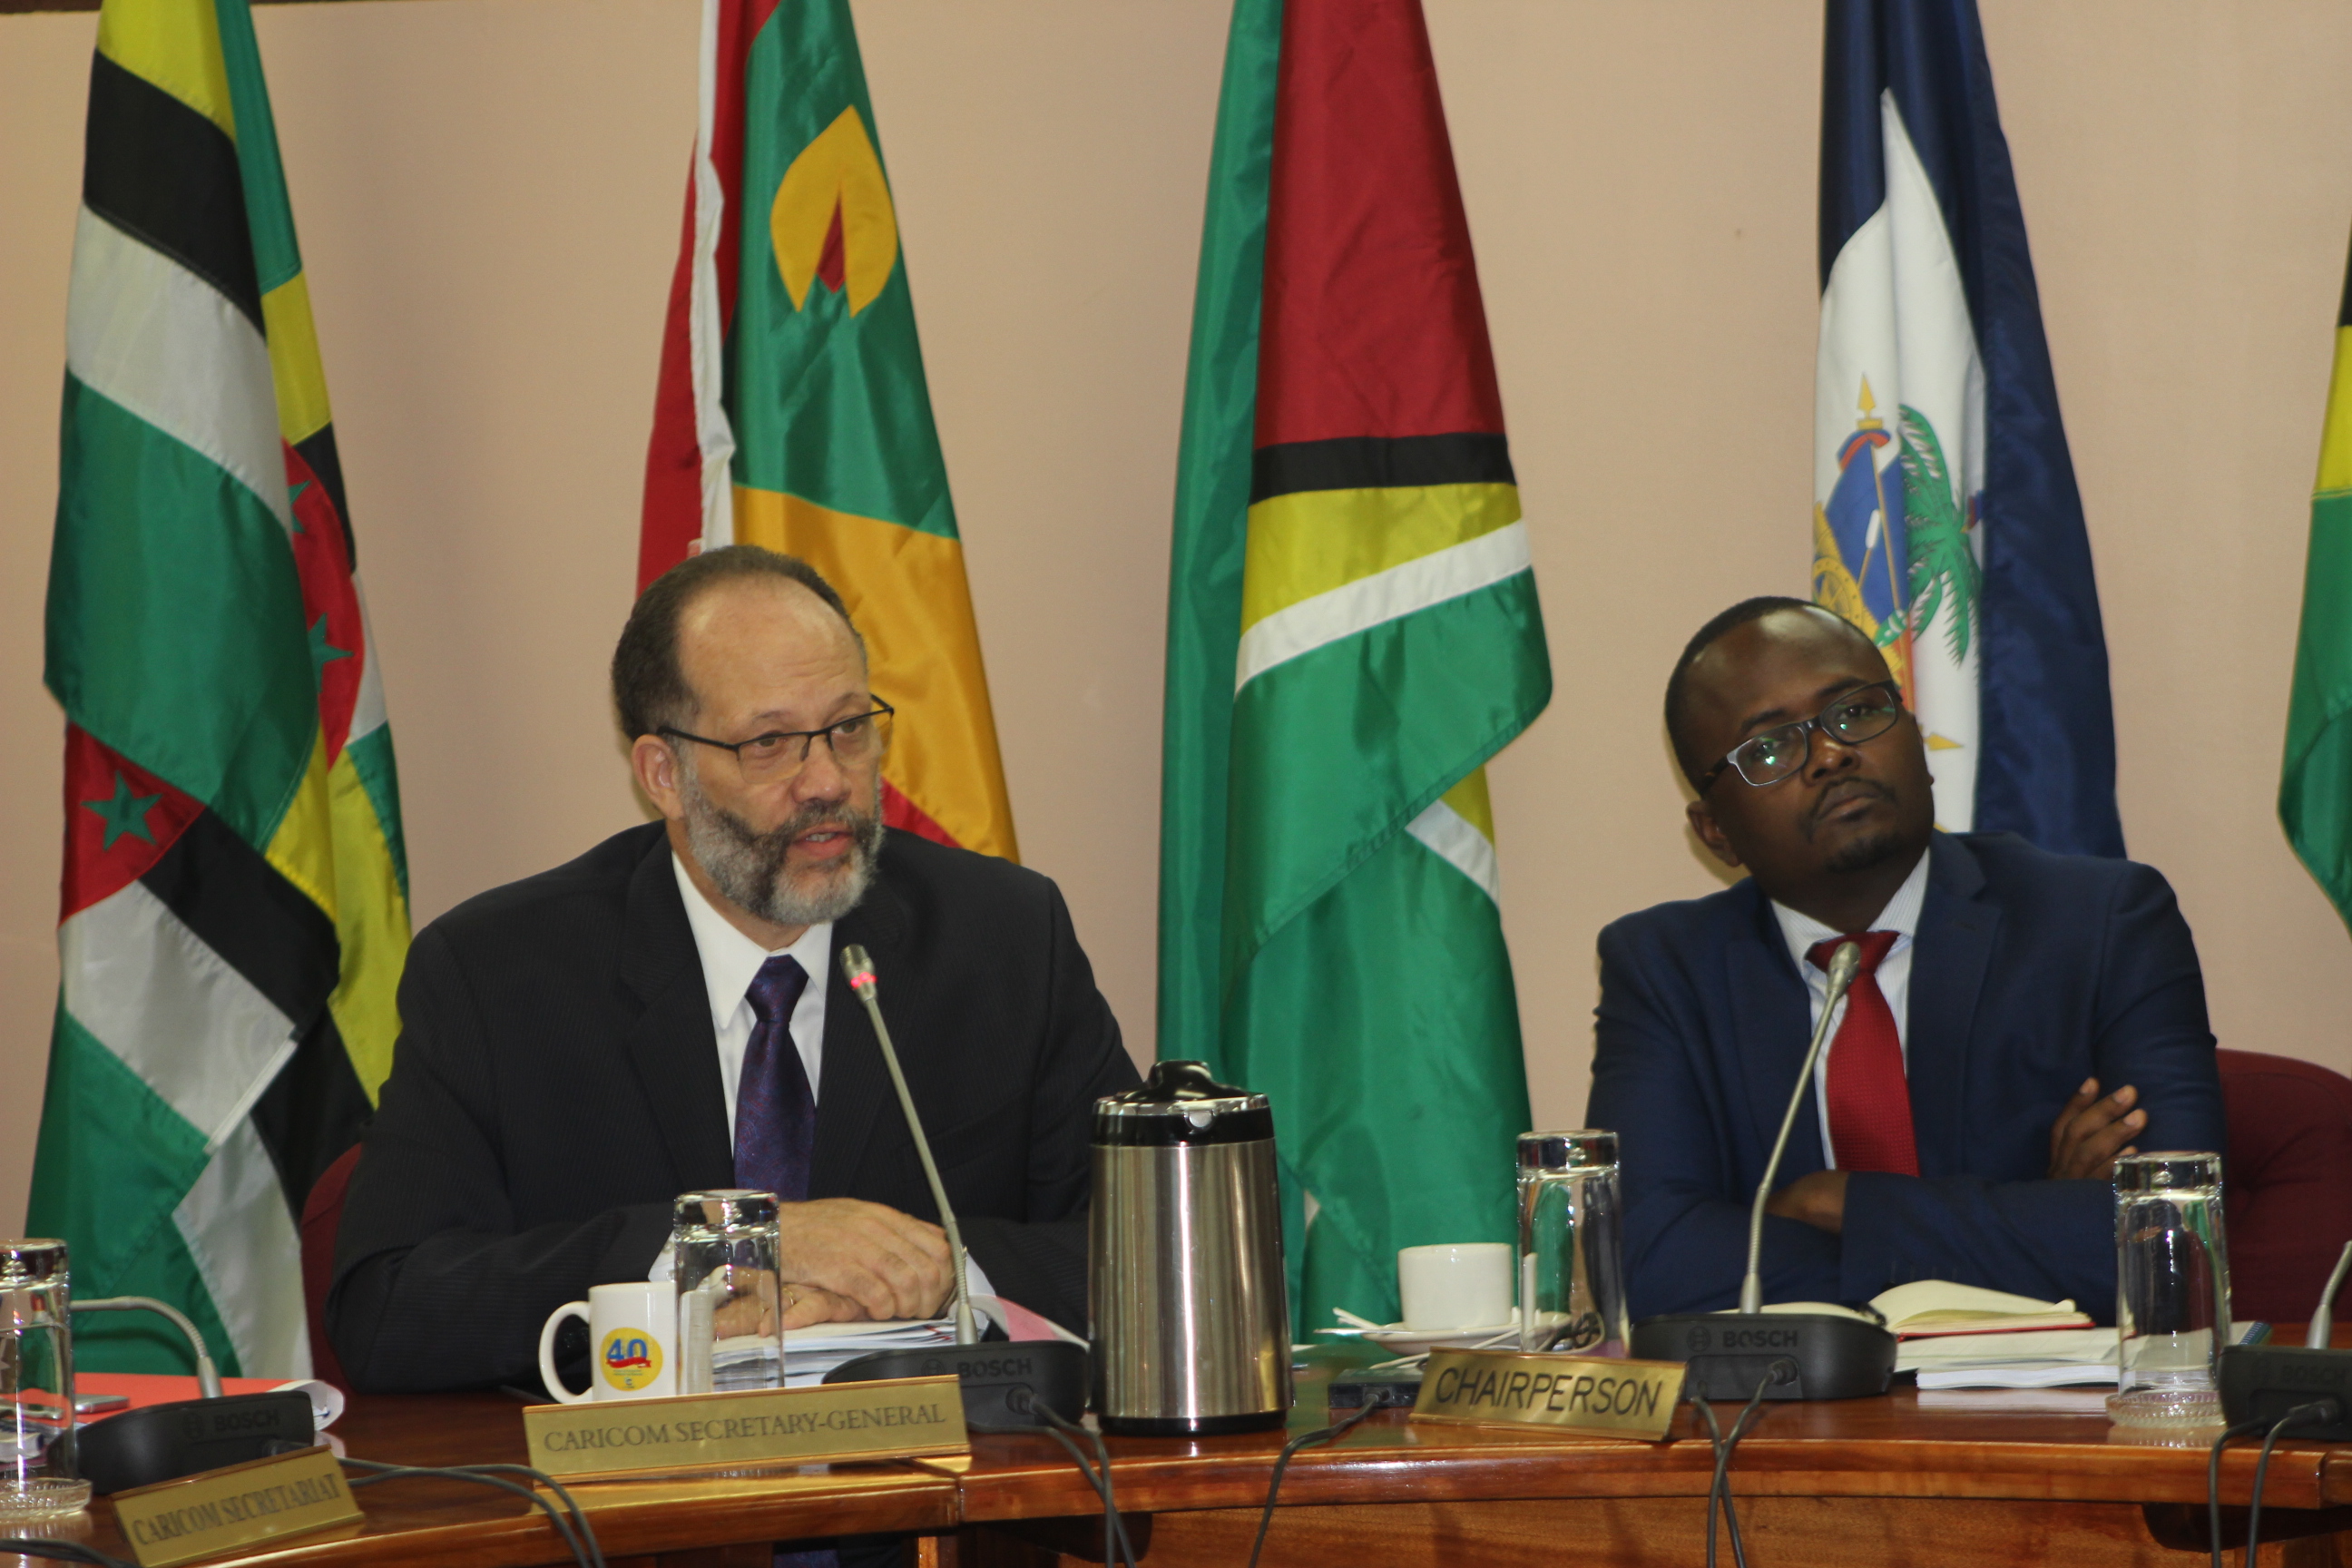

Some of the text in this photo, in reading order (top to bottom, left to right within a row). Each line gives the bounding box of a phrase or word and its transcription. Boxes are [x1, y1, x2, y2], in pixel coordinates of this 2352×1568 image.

[606, 1338, 648, 1362] 40
[1723, 1330, 1798, 1348] BOSCH
[957, 1357, 1033, 1377] BOSCH
[1436, 1367, 1662, 1416] CHAIRPERSON
[214, 1409, 280, 1432] BOSCH
[544, 1404, 946, 1452] CARICOM SECRETARY-GENERAL
[132, 1473, 341, 1545] CARICOM SECRETARIAT
